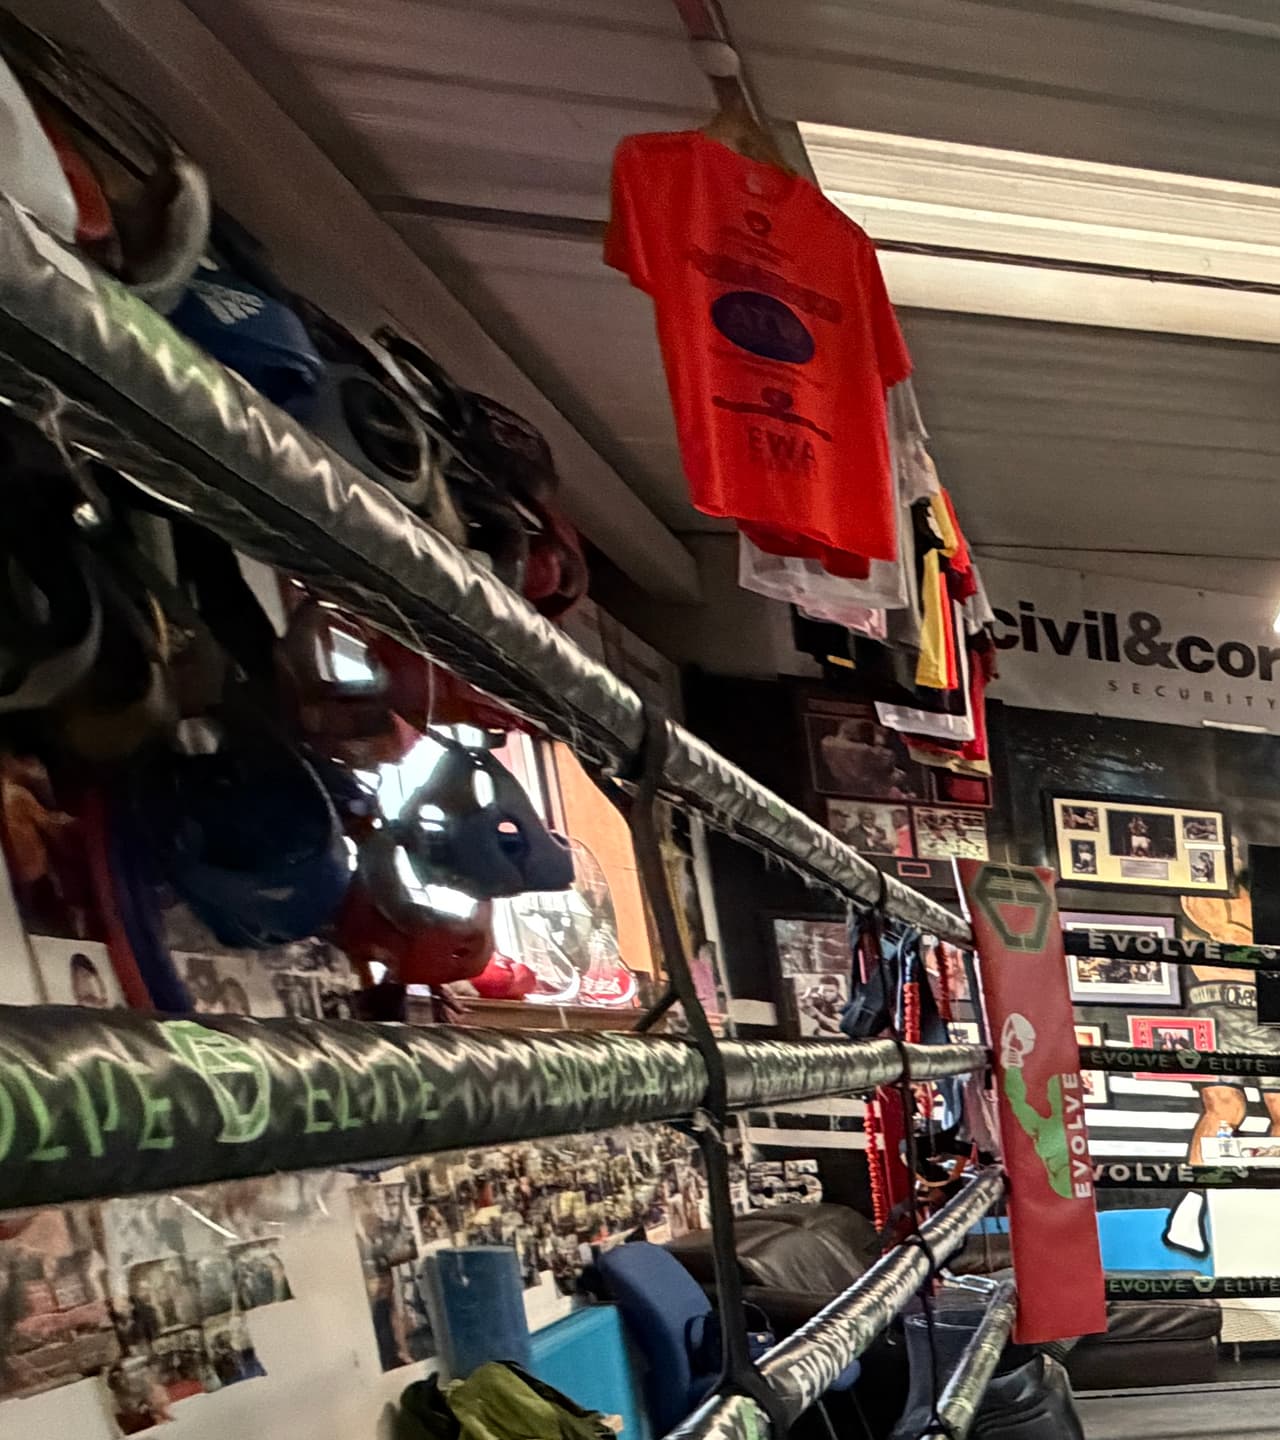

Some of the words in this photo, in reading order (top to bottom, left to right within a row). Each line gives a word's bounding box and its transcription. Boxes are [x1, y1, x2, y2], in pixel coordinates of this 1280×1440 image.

[1108, 680, 1277, 710] SECURITY
[1088, 931, 1222, 960] EVOLVE
[1091, 1051, 1170, 1068] EVOLVE
[1209, 1056, 1268, 1072] ELITE
[1061, 1072, 1092, 1199] EVOLVE
[1091, 1163, 1194, 1183] VOLVE
[1109, 1280, 1187, 1293] EVOLVE
[1224, 1280, 1280, 1292] ELITE
